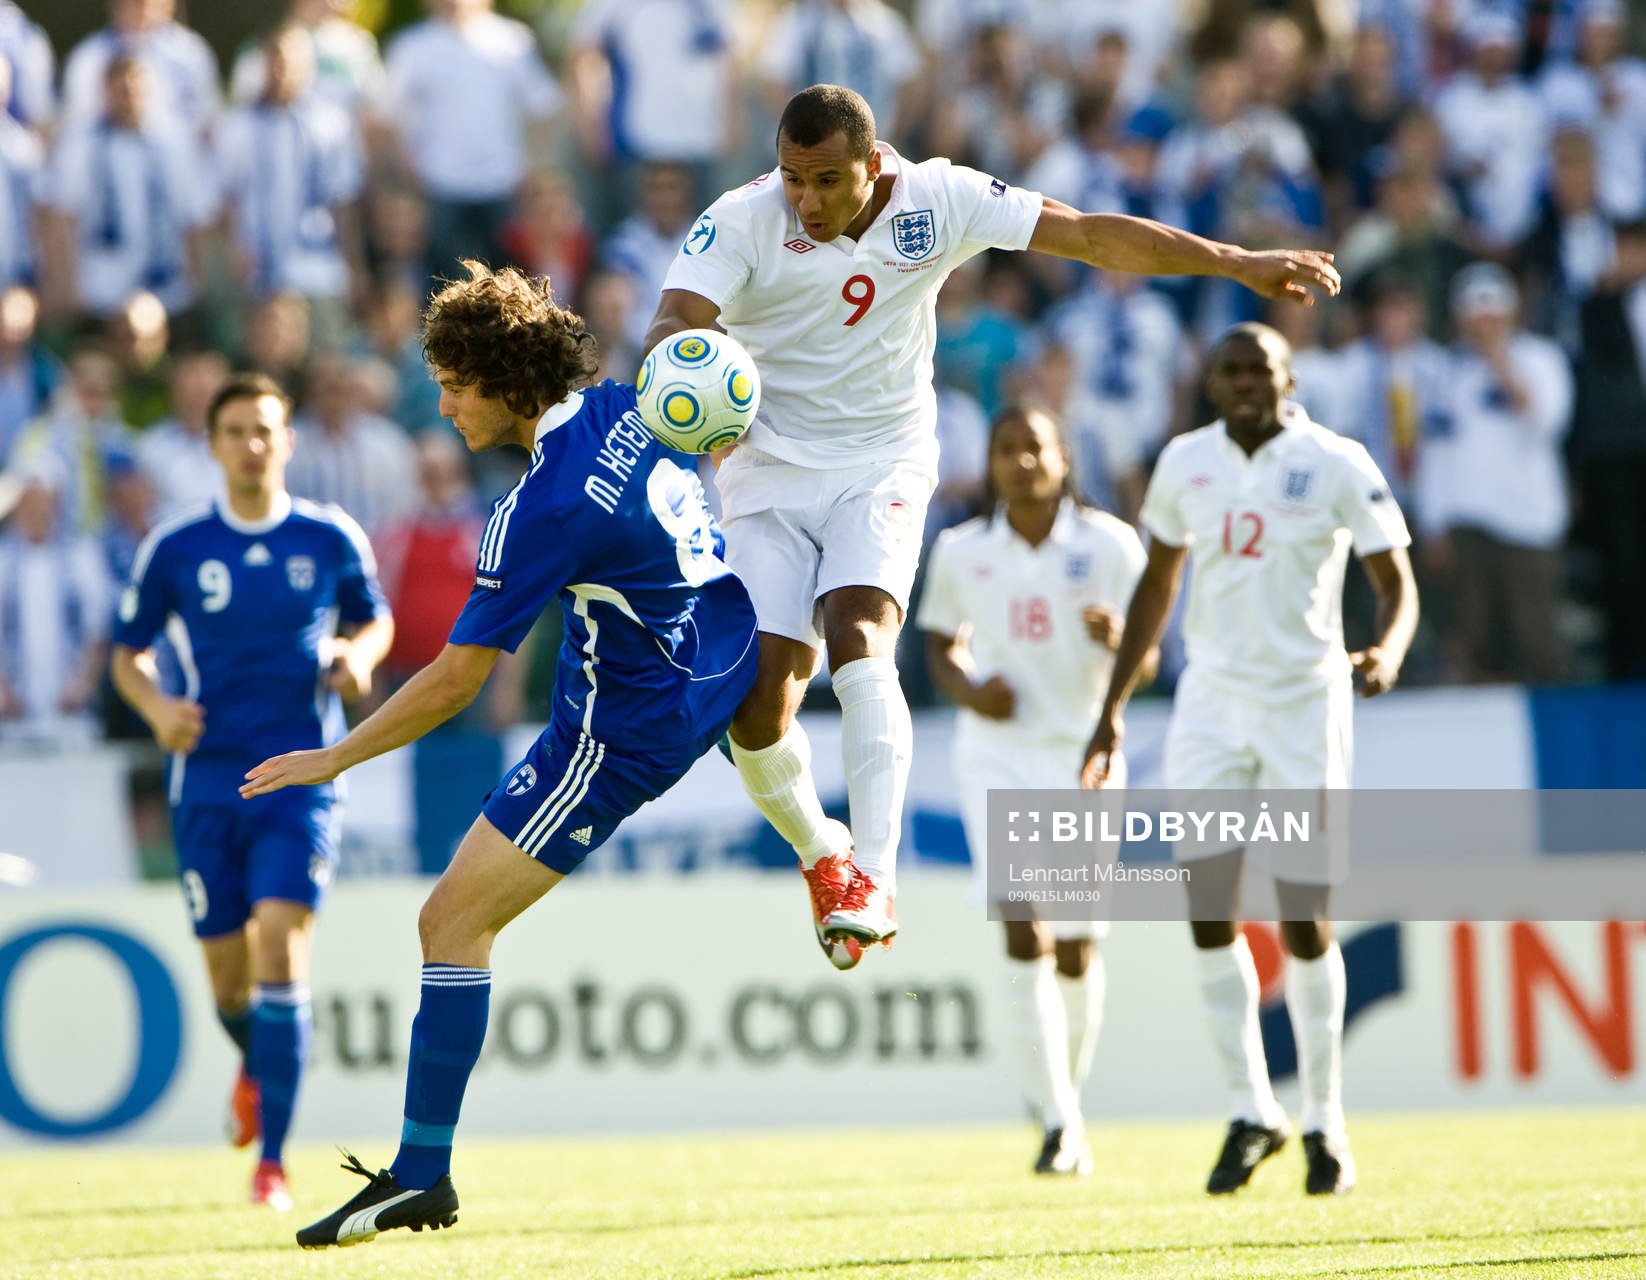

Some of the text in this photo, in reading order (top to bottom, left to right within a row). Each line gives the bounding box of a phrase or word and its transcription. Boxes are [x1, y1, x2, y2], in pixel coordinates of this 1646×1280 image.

[842, 274, 876, 327] 9
[584, 405, 655, 515] M. HETEM
[1222, 510, 1266, 560] 12
[197, 557, 233, 613] 9
[1009, 596, 1053, 643] 18
[569, 832, 591, 847] adidas
[1452, 915, 1646, 1082] IN
